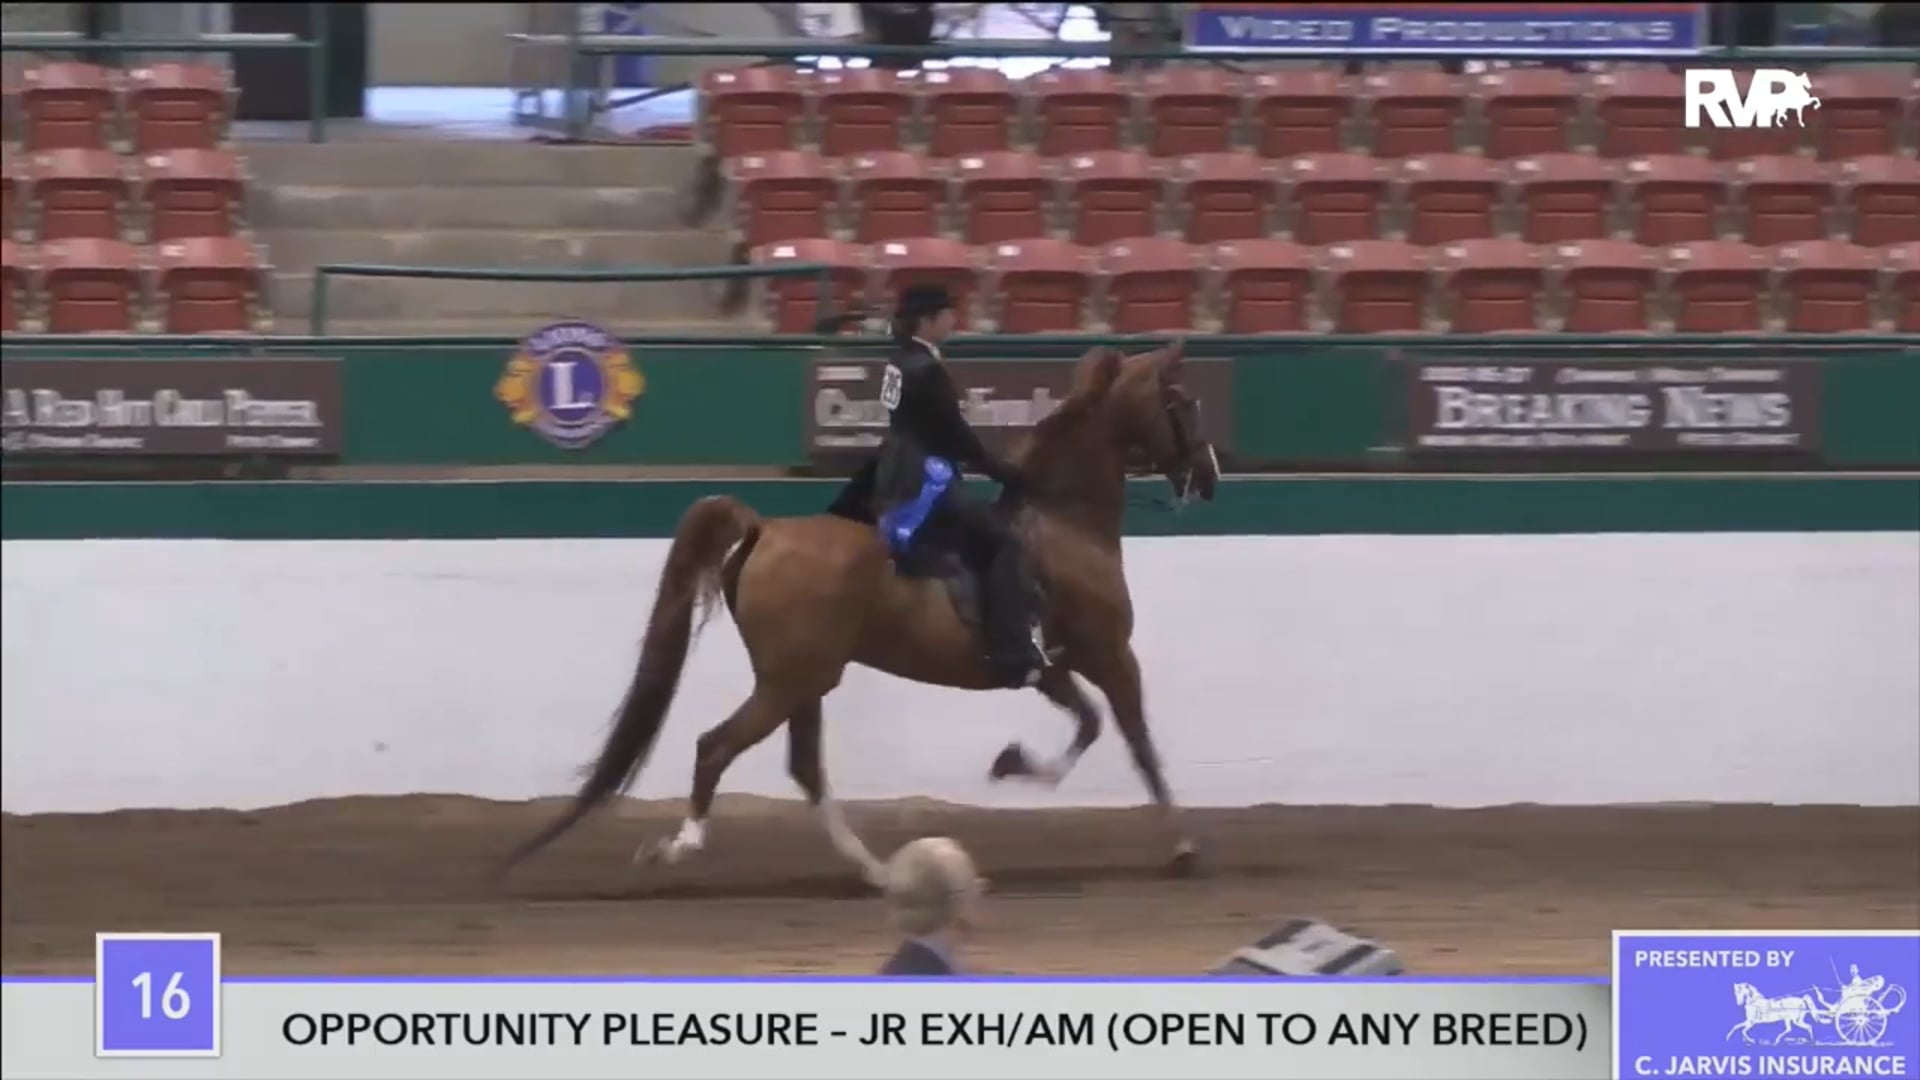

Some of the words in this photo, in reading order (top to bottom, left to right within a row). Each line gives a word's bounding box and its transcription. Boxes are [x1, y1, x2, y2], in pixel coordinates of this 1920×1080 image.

[1218, 16, 1355, 41] VIDEO
[1370, 16, 1674, 42] PRODUCTIONS
[549, 361, 597, 409] L
[1434, 385, 1652, 428] BREAKING
[1662, 385, 1790, 428] NEWS
